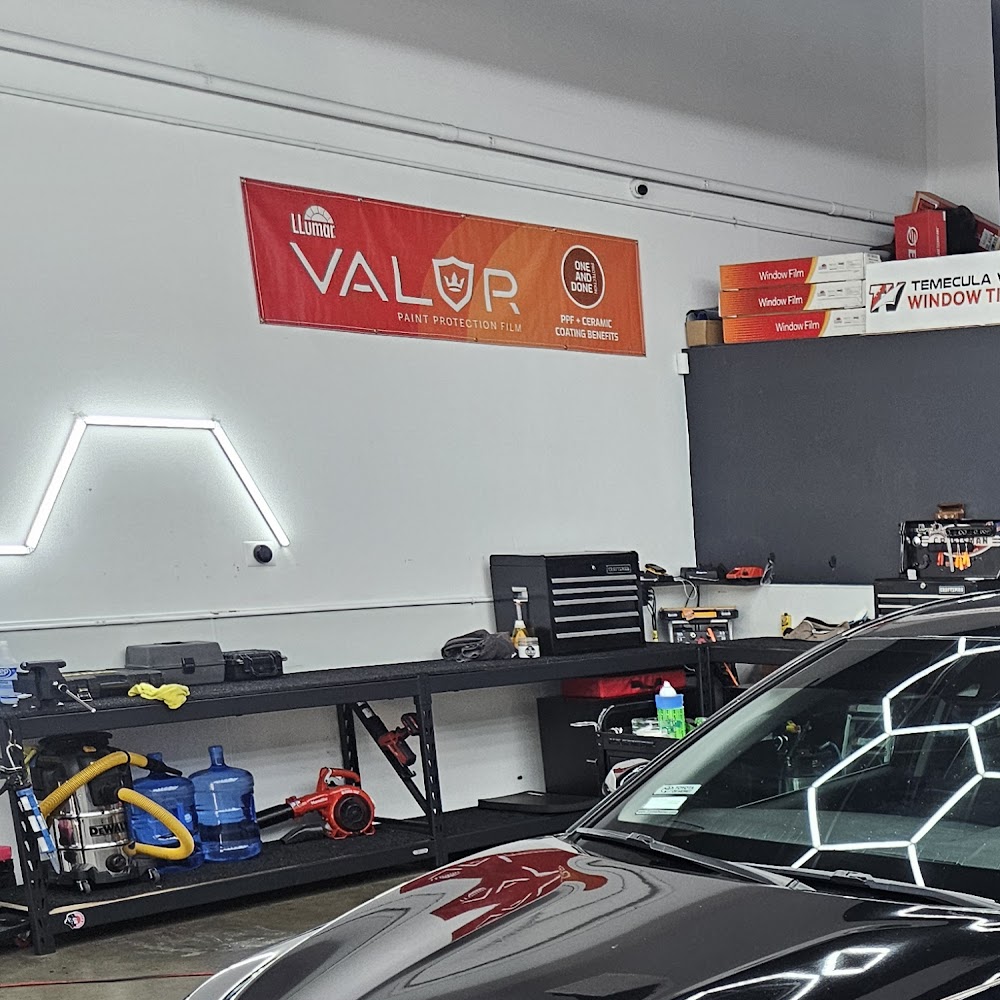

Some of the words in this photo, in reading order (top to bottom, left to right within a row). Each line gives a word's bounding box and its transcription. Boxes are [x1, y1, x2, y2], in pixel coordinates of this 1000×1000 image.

[574, 260, 591, 272] ONE
[575, 271, 592, 283] AND
[758, 270, 788, 282] Window
[788, 268, 805, 279] Film
[570, 281, 593, 294] DONE
[911, 273, 991, 292] TEMECULA
[758, 296, 788, 308] Window
[788, 295, 803, 305] Film
[907, 288, 982, 310] WINDOW
[397, 311, 429, 324] PAINT
[433, 315, 498, 330] PROTECTION
[500, 321, 522, 333] FILM
[560, 314, 575, 325] PPF
[581, 316, 613, 329] CERAMIC
[775, 321, 804, 333] Window
[804, 320, 820, 331] Film
[555, 326, 587, 339] COATING
[587, 329, 619, 342] BENEFITS
